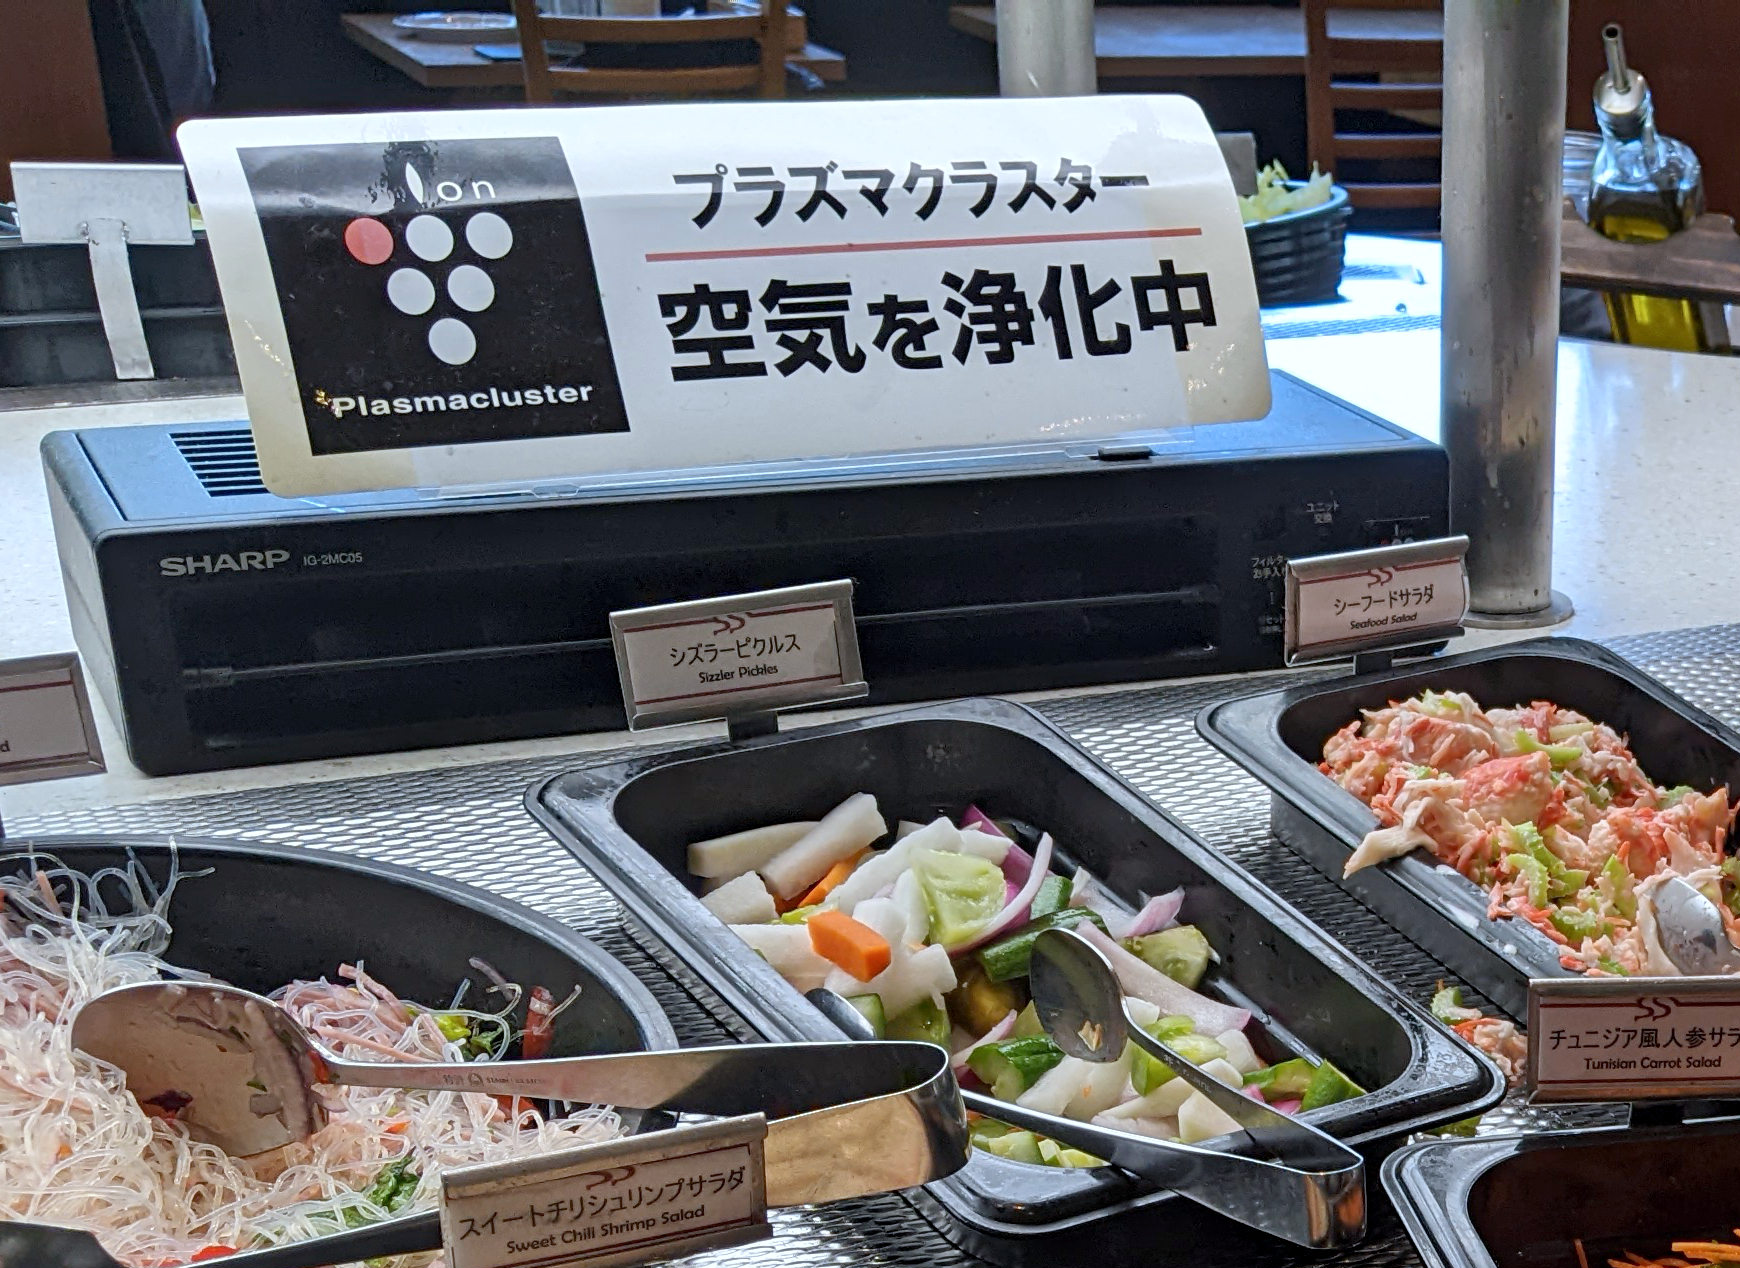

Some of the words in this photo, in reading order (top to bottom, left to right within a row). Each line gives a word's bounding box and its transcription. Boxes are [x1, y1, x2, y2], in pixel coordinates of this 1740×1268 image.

[673, 157, 1150, 230] プラズマクラスター
[657, 258, 1218, 382] 空気を浄化中
[332, 383, 594, 419] Plasmacluster
[159, 550, 291, 577] SHARP
[303, 552, 364, 566] IG-2MC05
[1334, 584, 1434, 616] シーフードサラダ
[1350, 616, 1388, 629] Seafood
[1391, 612, 1418, 624] Salad
[669, 633, 801, 667] シズラーピクルス
[699, 670, 735, 683] Sizzler
[739, 659, 779, 678] Pickles
[1584, 1057, 1637, 1070] Tunisian
[1640, 1056, 1682, 1069] Carrot
[1686, 1055, 1722, 1068] Salad
[459, 1165, 746, 1240] スイートチリシュリンプサラダ
[507, 1235, 557, 1254] Sweet
[601, 1215, 656, 1237] Shrimp
[661, 1204, 705, 1225] Salad
